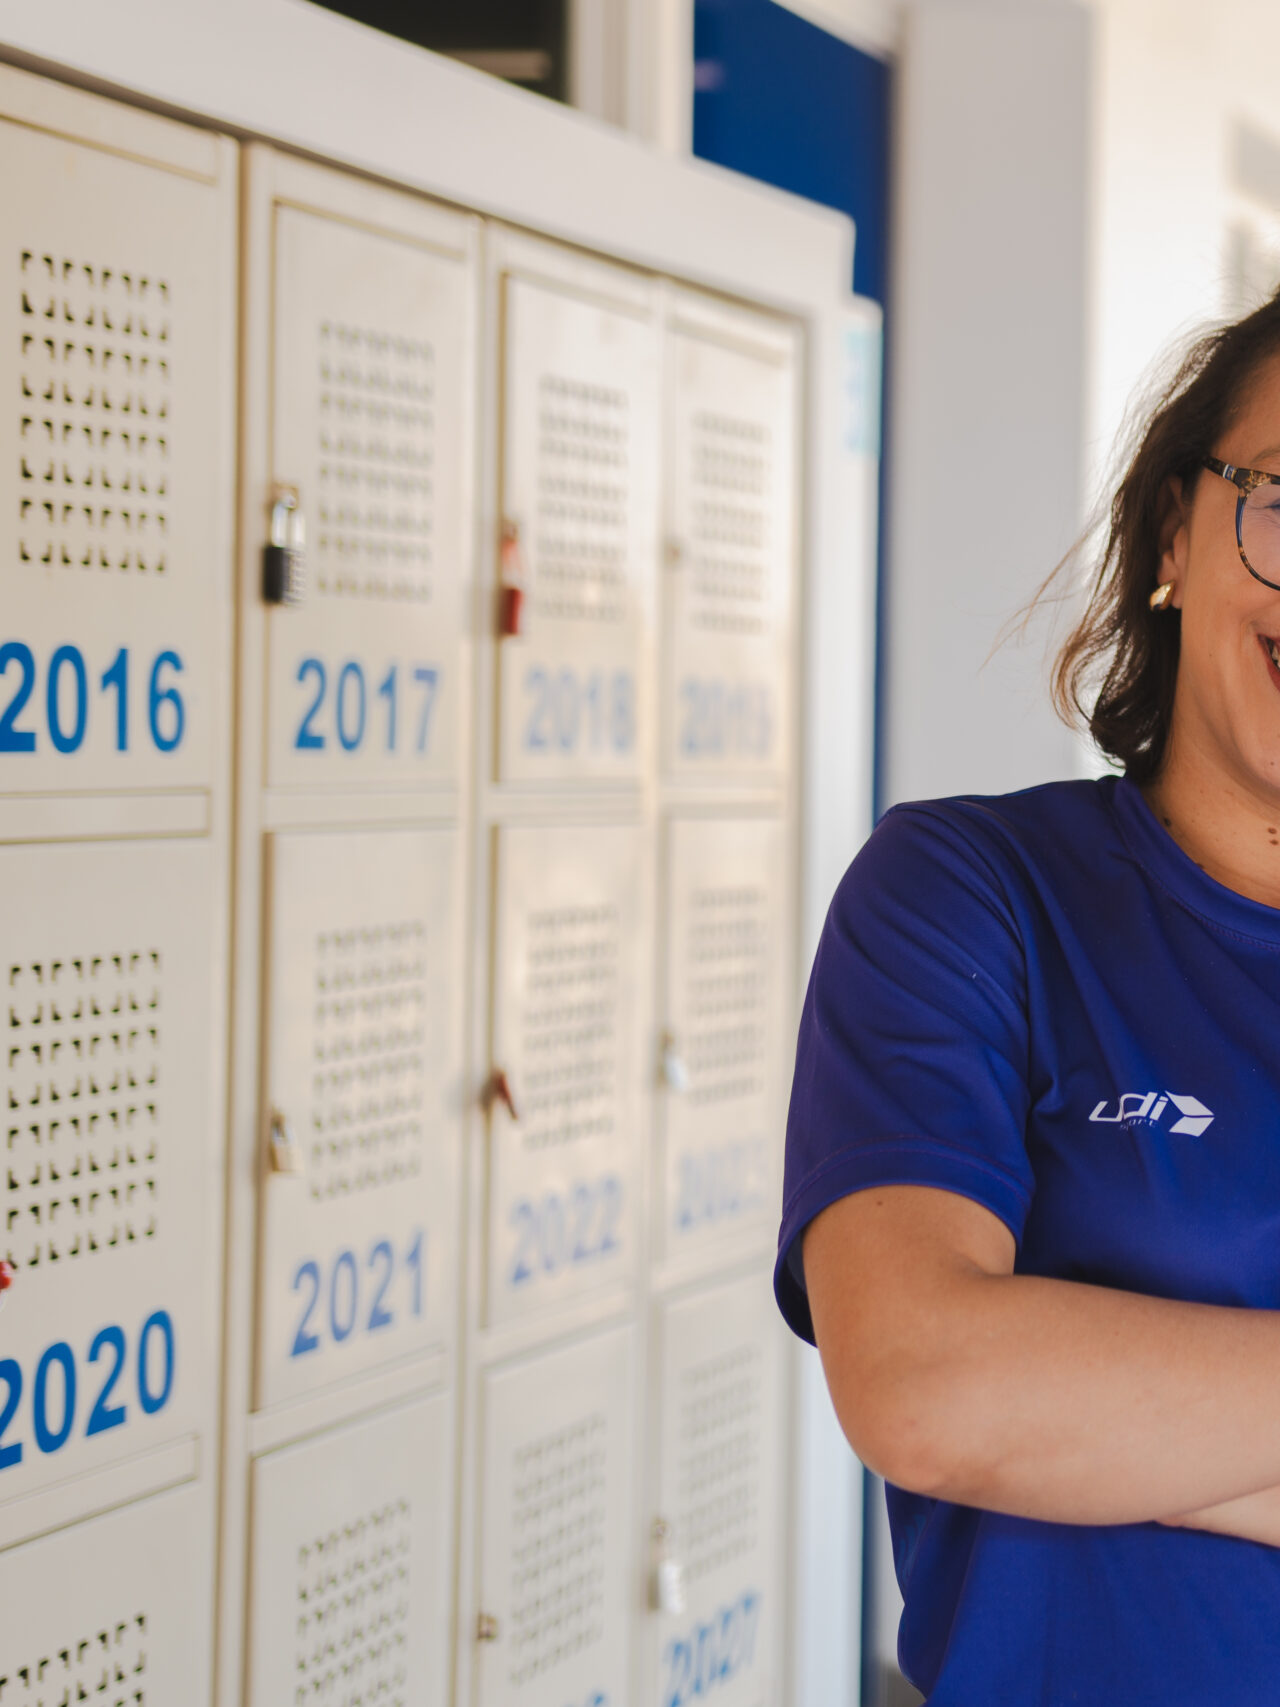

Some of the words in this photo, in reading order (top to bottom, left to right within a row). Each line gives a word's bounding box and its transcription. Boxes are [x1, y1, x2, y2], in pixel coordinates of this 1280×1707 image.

[0, 642, 184, 753] 2016
[294, 658, 438, 752] 2017
[290, 1230, 424, 1358] 2021
